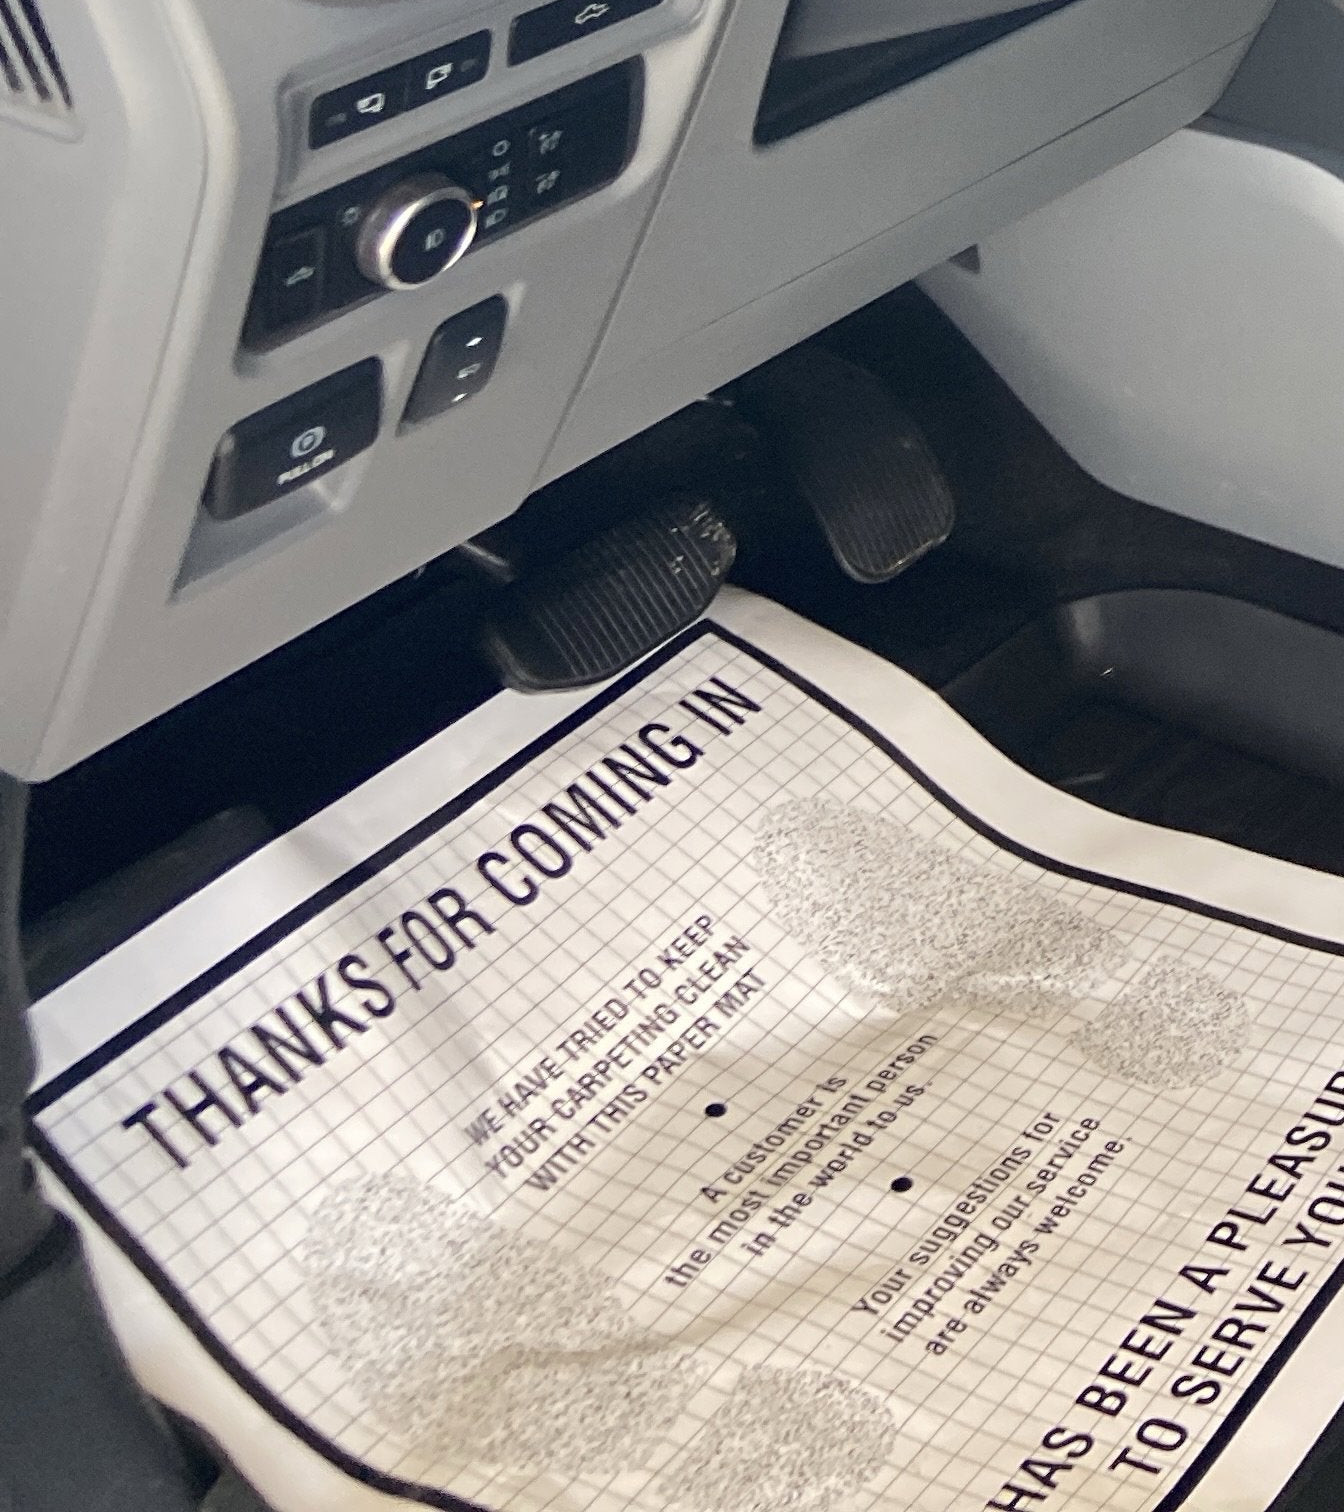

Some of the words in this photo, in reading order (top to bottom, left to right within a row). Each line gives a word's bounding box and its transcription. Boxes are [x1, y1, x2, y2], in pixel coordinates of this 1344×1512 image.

[122, 953, 396, 1169] THANKS
[376, 888, 497, 991] FOR
[476, 723, 705, 906] COMING
[679, 676, 762, 737] IN
[465, 1107, 504, 1147] WE
[497, 1057, 565, 1118] HAVE
[556, 997, 630, 1061] TRIED
[623, 967, 662, 999] TO
[656, 914, 714, 970] KEEP
[485, 1117, 557, 1179] YOUR
[551, 1003, 681, 1120] CARPETING
[674, 935, 752, 1006] CLEAN
[525, 1132, 597, 1191] WITH
[587, 1082, 649, 1133] THIS
[642, 1014, 722, 1086] PAPER
[713, 967, 767, 1019] MAT
[664, 1247, 713, 1288] the
[707, 1189, 771, 1245] most
[760, 1092, 872, 1188] important
[865, 1033, 939, 1094] person
[700, 1186, 728, 1204] A
[723, 1095, 824, 1186] customer
[815, 1075, 849, 1095] is
[740, 1231, 777, 1258] in
[768, 1191, 814, 1229] the
[808, 1129, 876, 1189] world
[865, 1110, 898, 1131] to
[850, 1267, 913, 1317] Your
[909, 1144, 1032, 1266] suggestions
[1021, 1111, 1061, 1143] for
[880, 1232, 1001, 1345] improving
[991, 1194, 1032, 1232] our
[1026, 1116, 1102, 1195] service
[925, 1317, 969, 1357] are
[963, 1238, 1041, 1316] always
[1033, 1136, 1133, 1236] welcome.
[985, 1426, 1094, 1511] HAS
[1074, 1299, 1200, 1418] BEEN
[1177, 1264, 1232, 1296] A
[1107, 1417, 1189, 1475] TO
[1171, 1259, 1310, 1406] SERVE
